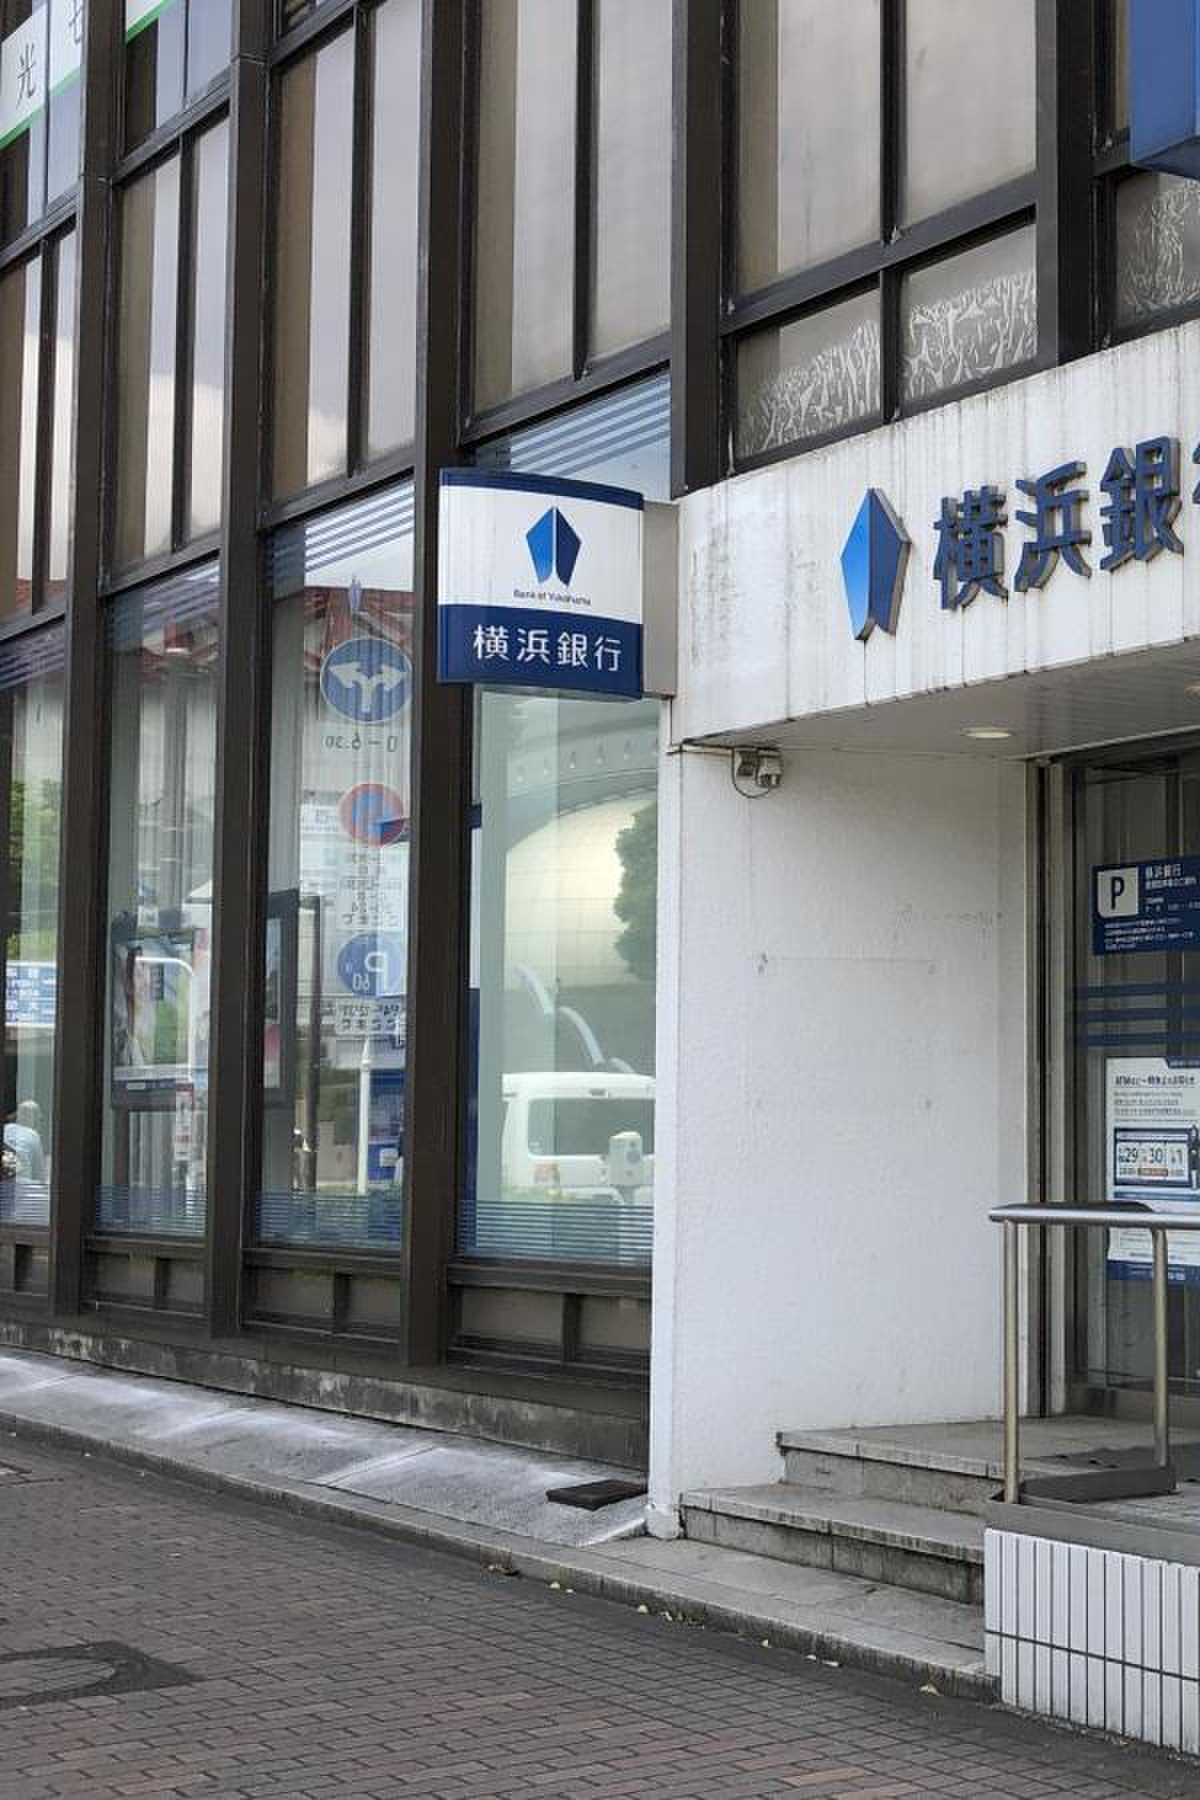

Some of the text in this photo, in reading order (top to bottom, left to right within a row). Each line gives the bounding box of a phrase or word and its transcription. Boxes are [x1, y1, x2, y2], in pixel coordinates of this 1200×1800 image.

[513, 588, 592, 606] Bank of Yokohama
[473, 623, 622, 672] 横浜銀行
[1110, 876, 1125, 911] P
